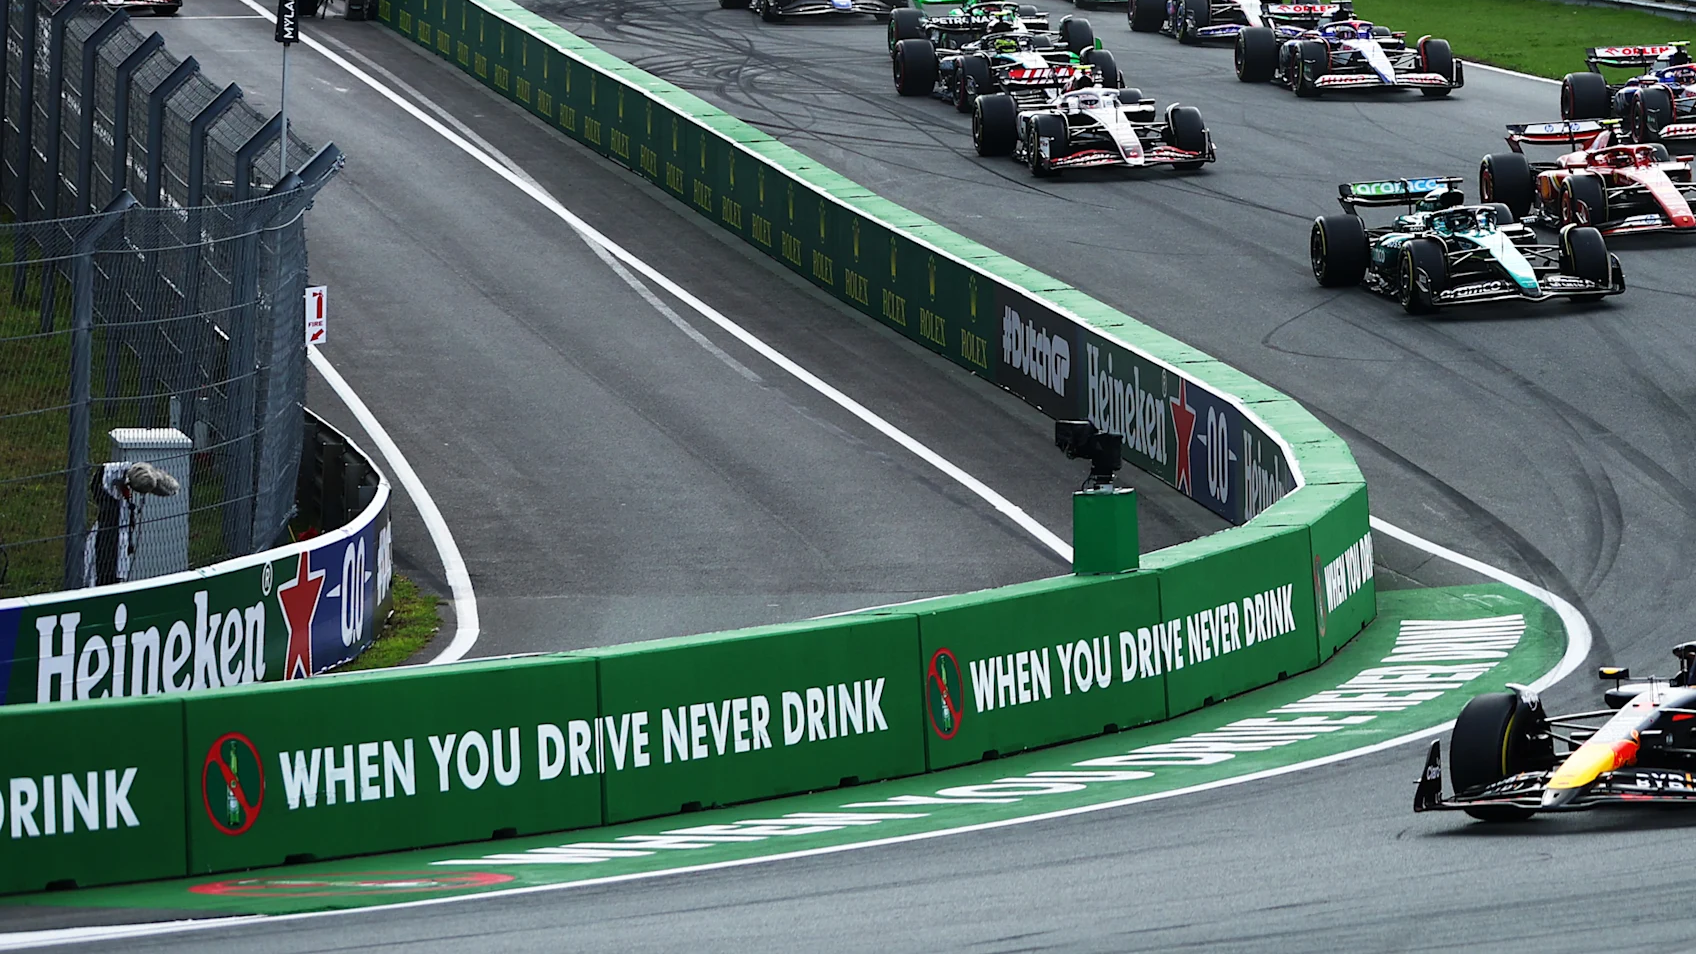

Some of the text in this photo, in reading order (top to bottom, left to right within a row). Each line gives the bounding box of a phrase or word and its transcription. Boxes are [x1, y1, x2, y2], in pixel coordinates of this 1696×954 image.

[640, 145, 657, 177] ROLEX
[666, 162, 684, 194] ROLEX
[693, 178, 712, 212] ROLEX
[722, 196, 742, 229] ROLEX
[752, 213, 772, 247] ROLEX
[781, 231, 802, 266] ROLEX
[812, 249, 834, 285] ROLEX
[845, 268, 869, 306] ROLEX
[919, 307, 946, 347] ROLEX
[960, 328, 988, 369] ROLEX
[1087, 342, 1229, 504] Heineken 0.0
[35, 591, 266, 704] Heineken
[340, 536, 366, 647] 0.0
[969, 583, 1296, 714] WHEN YOU DRIVE NEVER DRINK
[279, 677, 889, 810] WHEN YOU DRIVE NEVER DRINK
